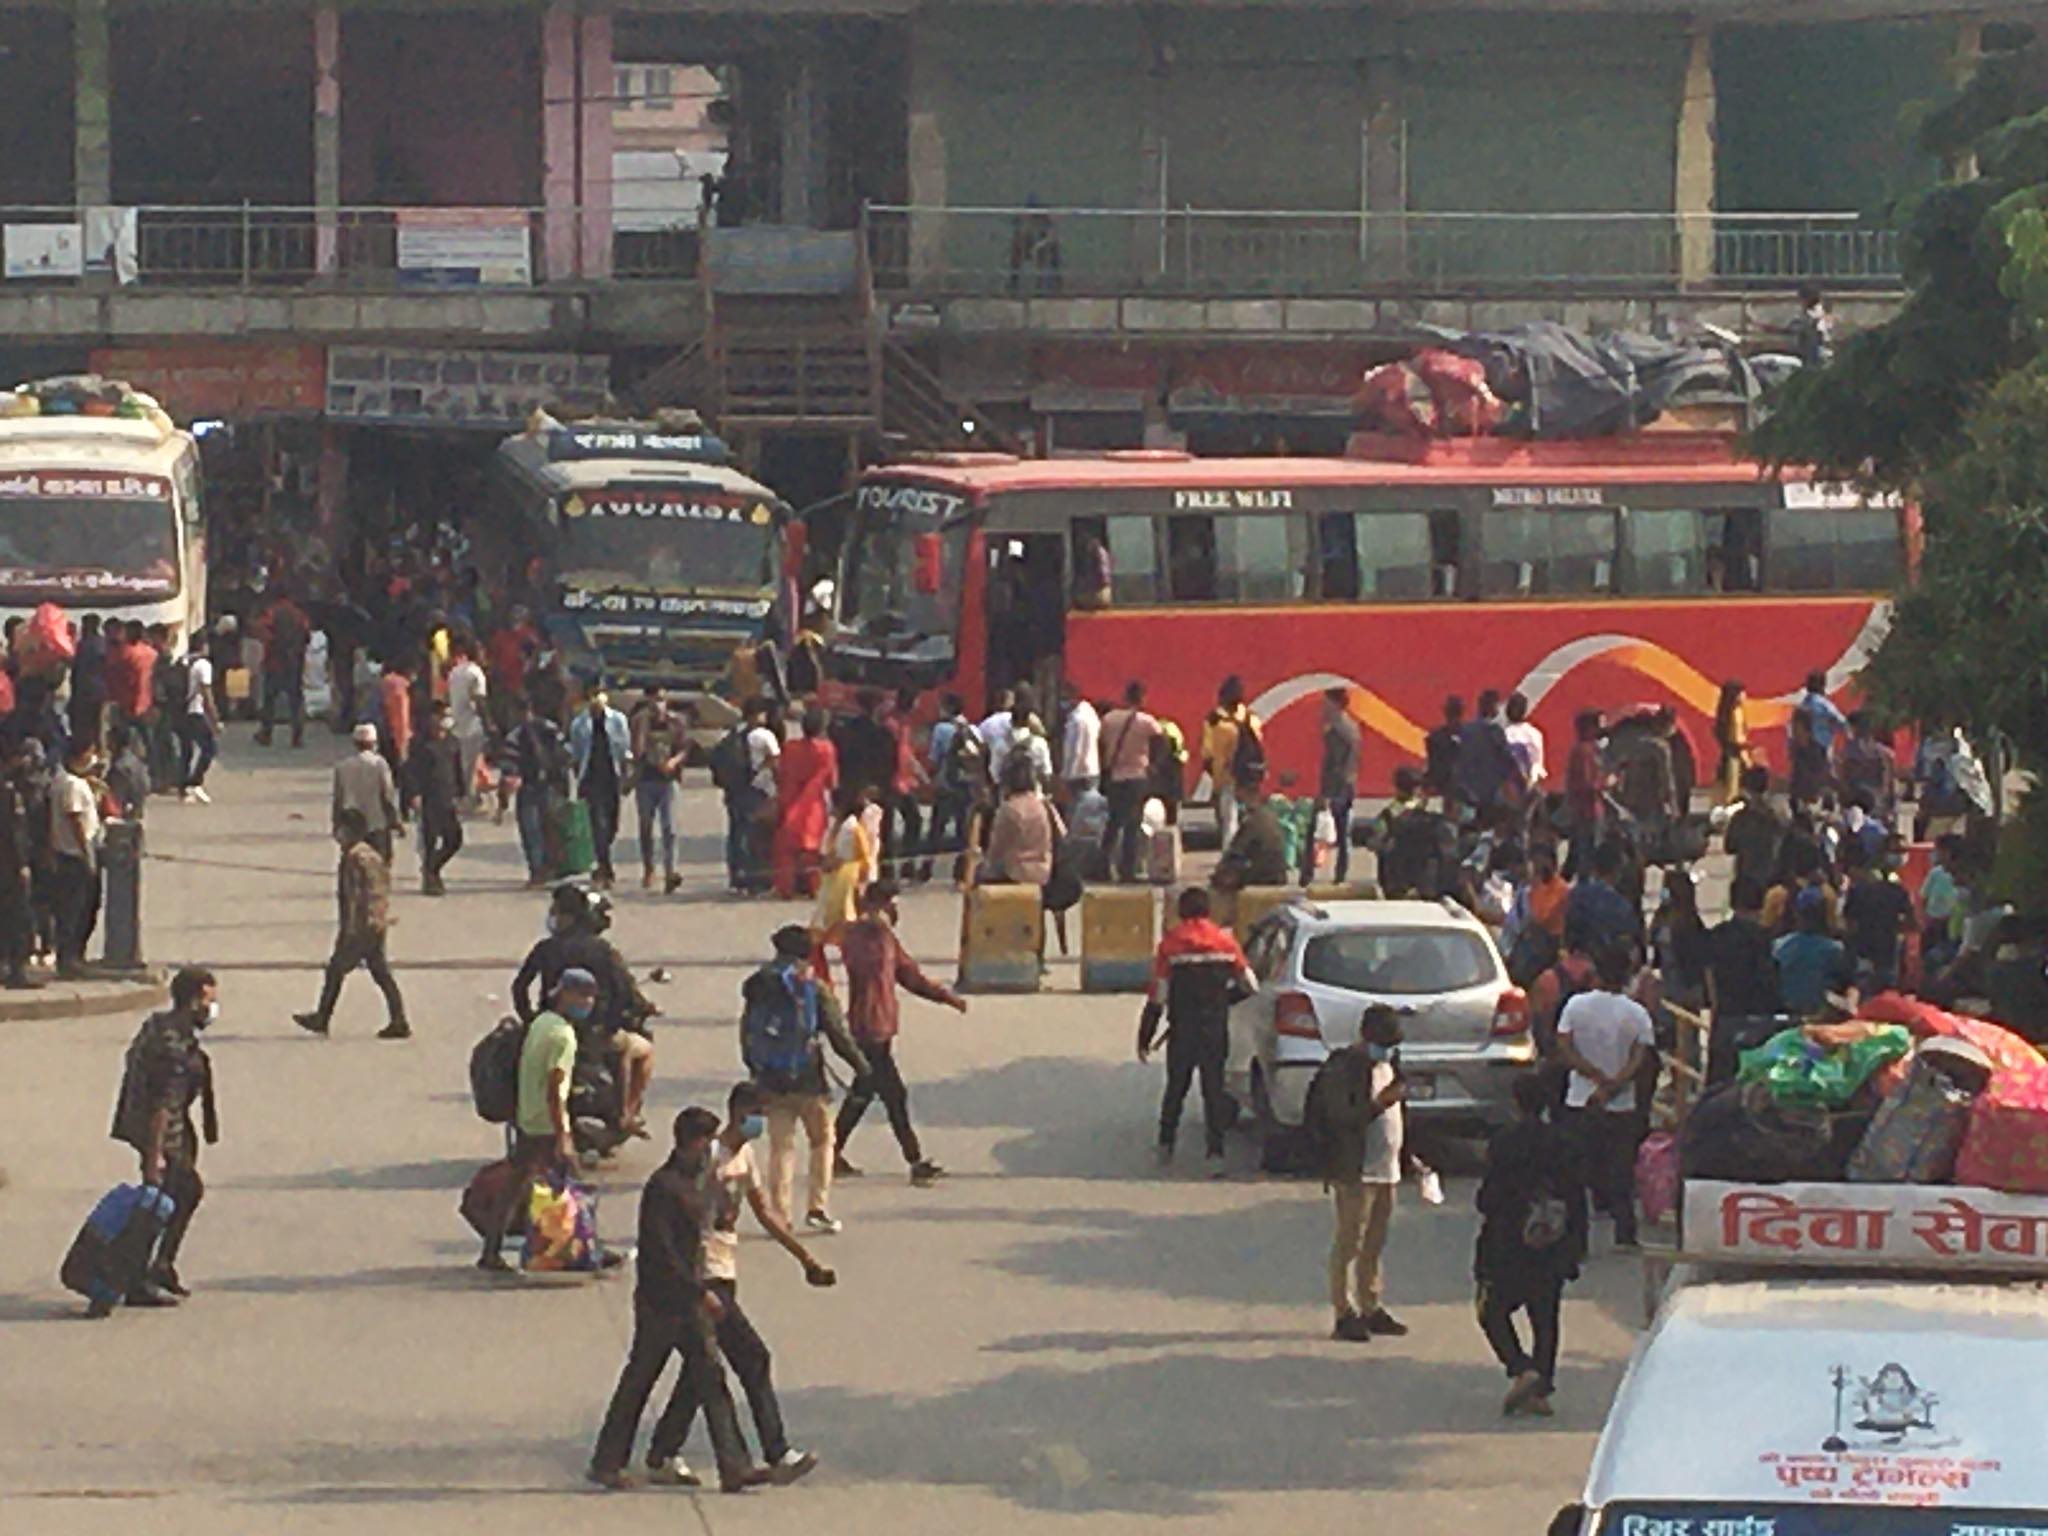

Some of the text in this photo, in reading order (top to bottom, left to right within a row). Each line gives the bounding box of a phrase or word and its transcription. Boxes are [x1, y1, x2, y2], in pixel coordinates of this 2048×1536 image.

[857, 486, 965, 518] TOURIST
[1175, 490, 1231, 508] FREE
[1719, 1191, 2048, 1255] दिवा सेव
